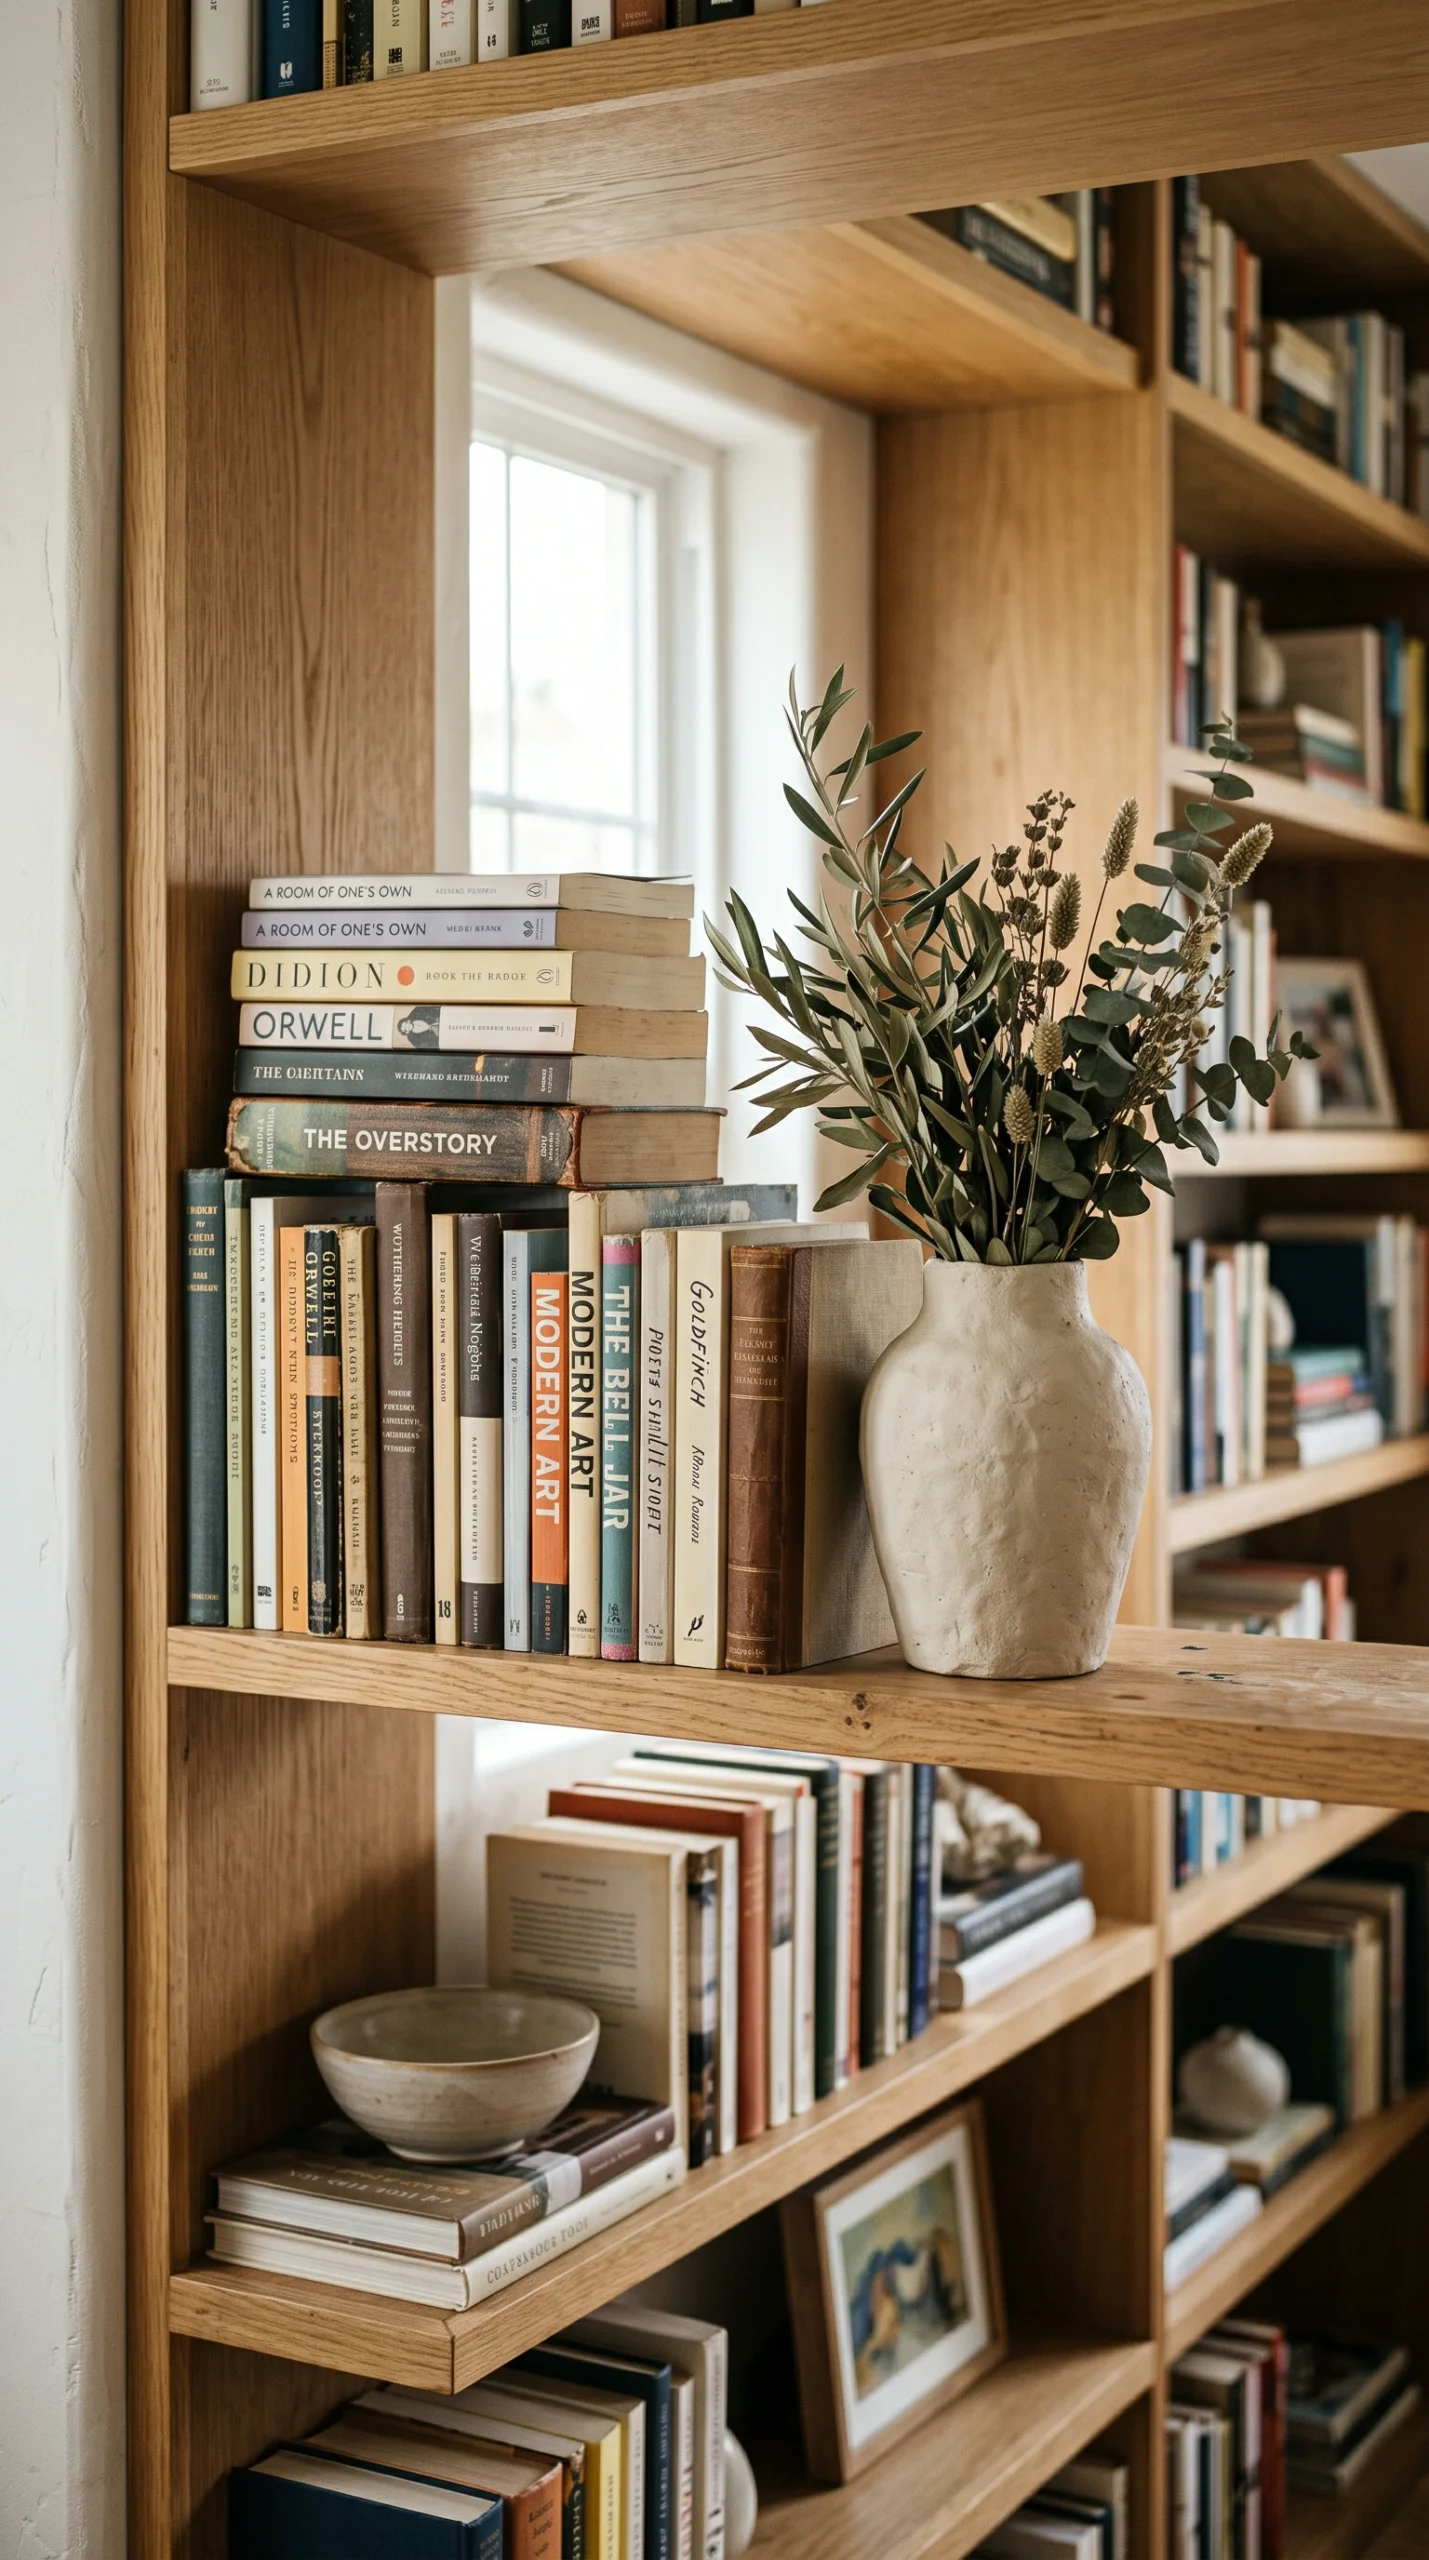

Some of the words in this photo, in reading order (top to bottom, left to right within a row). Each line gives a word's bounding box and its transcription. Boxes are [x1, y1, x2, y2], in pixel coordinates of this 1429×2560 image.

[264, 888, 273, 899] A
[276, 886, 314, 899] ROOM
[318, 886, 335, 898] OF
[337, 886, 375, 898] ONE'S
[378, 885, 412, 898] OWN
[256, 924, 266, 937] A
[270, 924, 314, 936] ROOM
[318, 924, 337, 936] OF
[341, 923, 384, 936] ONE'S
[389, 923, 426, 936] OWN
[246, 962, 387, 989] DIDION
[461, 972, 483, 981] THE
[252, 1010, 383, 1041] ORWELL
[253, 1066, 283, 1080] THE
[303, 1127, 348, 1151] THE
[354, 1129, 498, 1155] OVERSTORY
[603, 1285, 631, 1355] THE
[535, 1287, 560, 1442] MODERN
[570, 1270, 595, 1419] MODERN
[602, 1367, 630, 1453] BELL
[535, 1453, 560, 1525] ART
[570, 1433, 595, 1498] ART
[603, 1463, 630, 1532] JAR
[437, 1600, 451, 1618] 18
